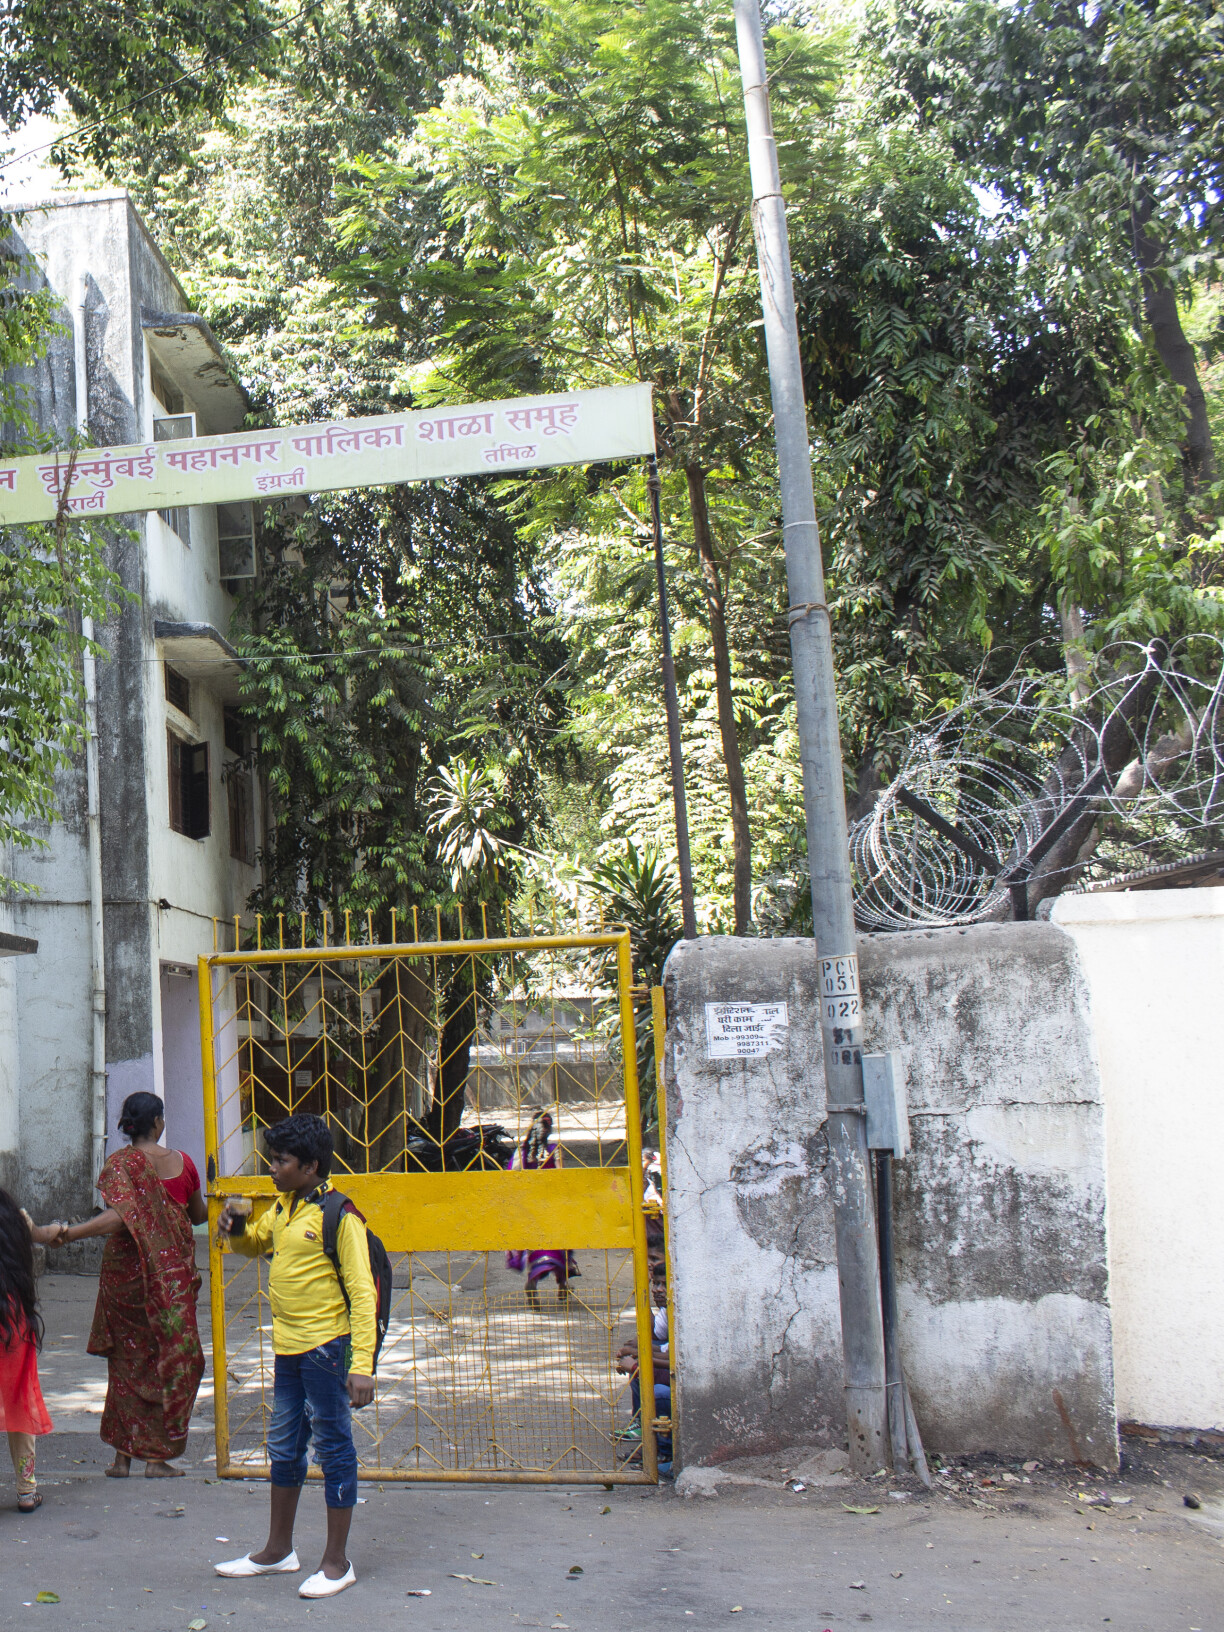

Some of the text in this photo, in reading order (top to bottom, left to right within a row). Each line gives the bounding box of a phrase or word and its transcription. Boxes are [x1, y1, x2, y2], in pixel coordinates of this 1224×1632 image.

[166, 440, 281, 472] महानगर
[292, 426, 405, 458] पालिका
[418, 413, 494, 442] शाळा
[505, 403, 580, 436] समूह
[255, 467, 305, 492] इंग्रजी
[483, 443, 537, 463] तमिळ
[825, 975, 856, 992] 051
[827, 999, 859, 1018] 022
[733, 1015, 754, 1023] काम
